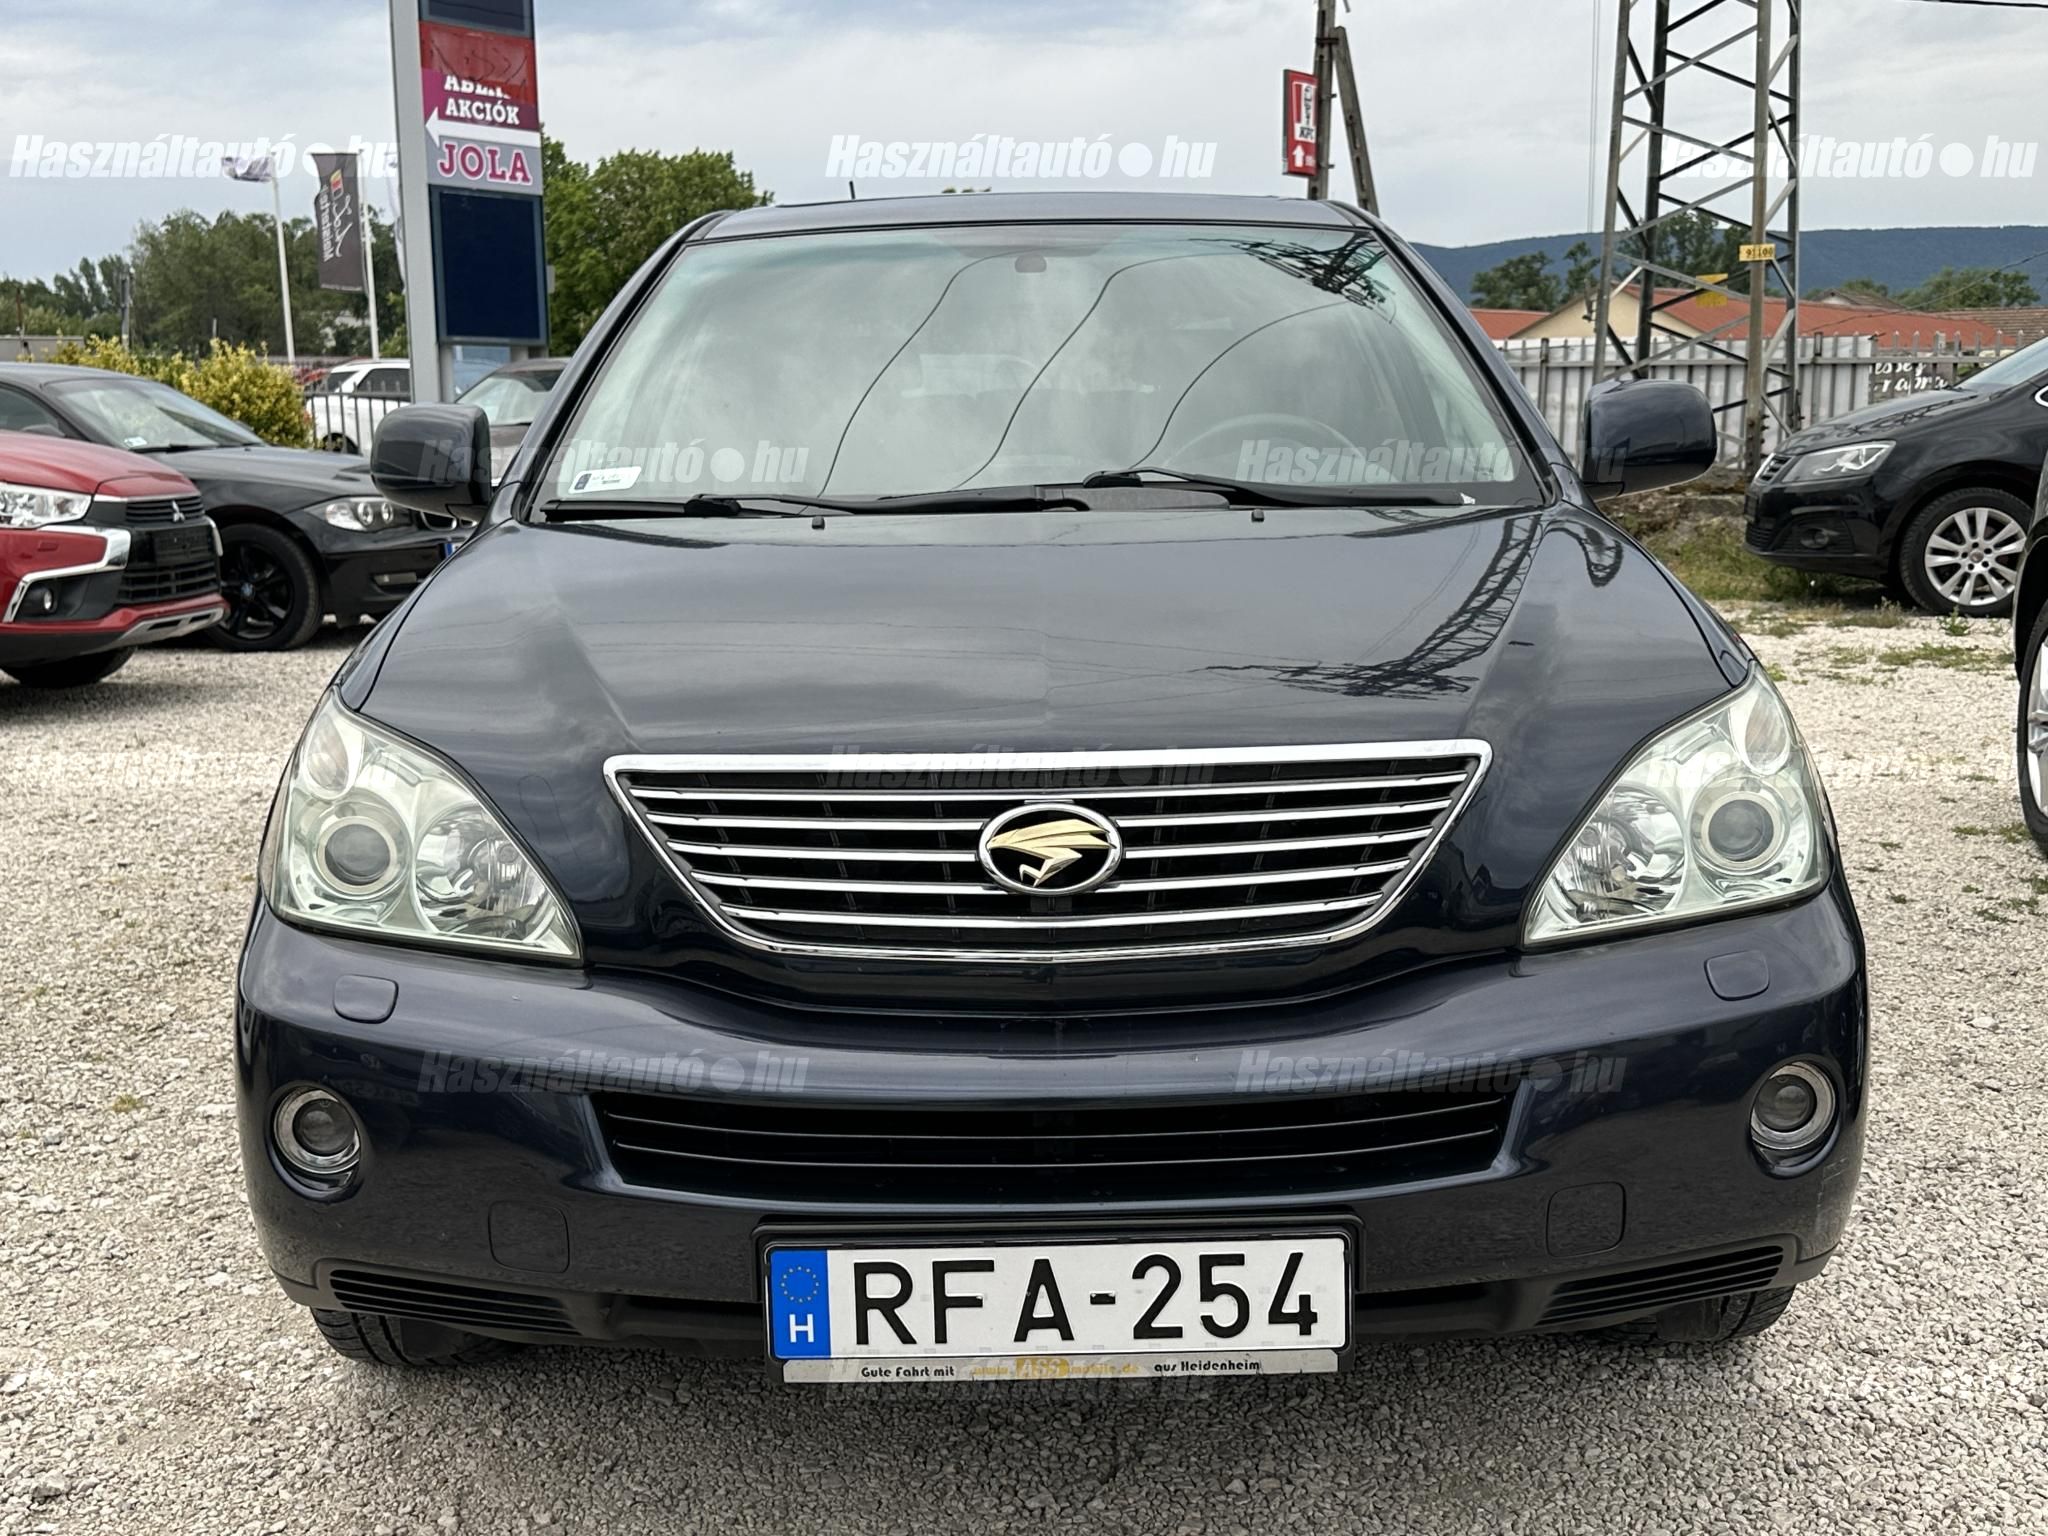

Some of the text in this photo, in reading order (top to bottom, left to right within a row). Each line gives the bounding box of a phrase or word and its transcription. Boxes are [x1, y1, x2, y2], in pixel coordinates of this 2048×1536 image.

[445, 98, 520, 125] AKCIÓK
[438, 142, 531, 184] JOLA
[853, 1251, 1319, 1346] RFA-254
[789, 1314, 815, 1344] H
[861, 1366, 892, 1379] Gute
[894, 1365, 930, 1379] Fahrt
[931, 1364, 955, 1378] mit
[1154, 1361, 1177, 1373] aus
[1180, 1358, 1261, 1372] Heidenheim
